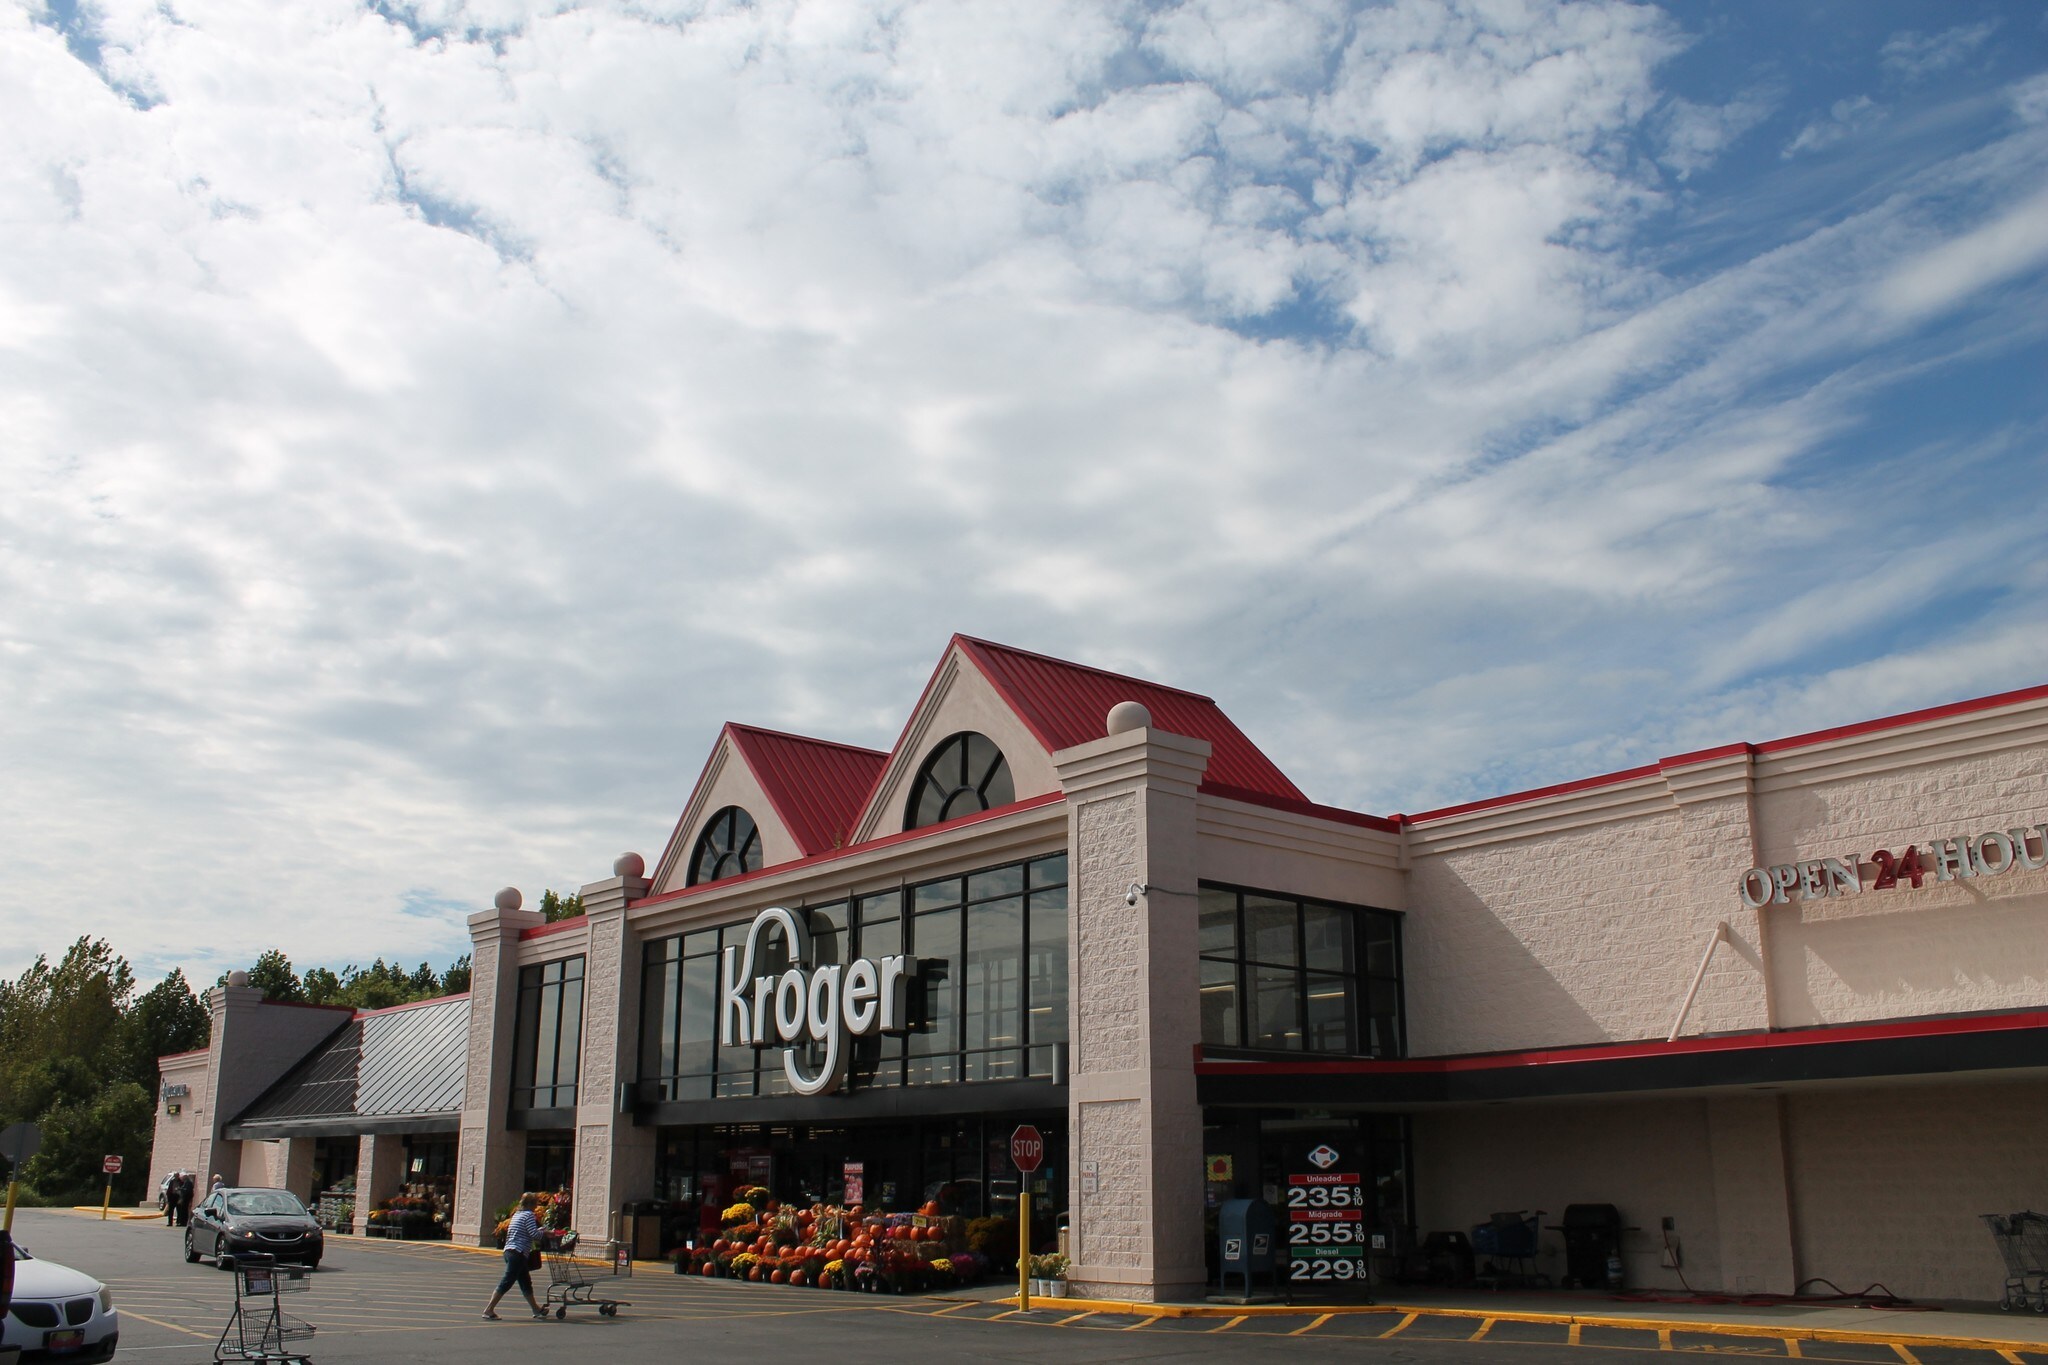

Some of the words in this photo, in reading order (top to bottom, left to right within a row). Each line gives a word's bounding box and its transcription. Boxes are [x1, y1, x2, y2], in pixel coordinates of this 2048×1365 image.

[1738, 853, 1862, 908] OPEN
[1871, 844, 1926, 891] 24
[722, 906, 906, 1096] Kroger
[1013, 1139, 1041, 1157] STOP
[1307, 1175, 1341, 1183] Unleaded
[1287, 1186, 1351, 1208] 235
[1308, 1211, 1342, 1219] Midgrade
[1289, 1223, 1353, 1244] 255
[1290, 1259, 1355, 1280] 229
